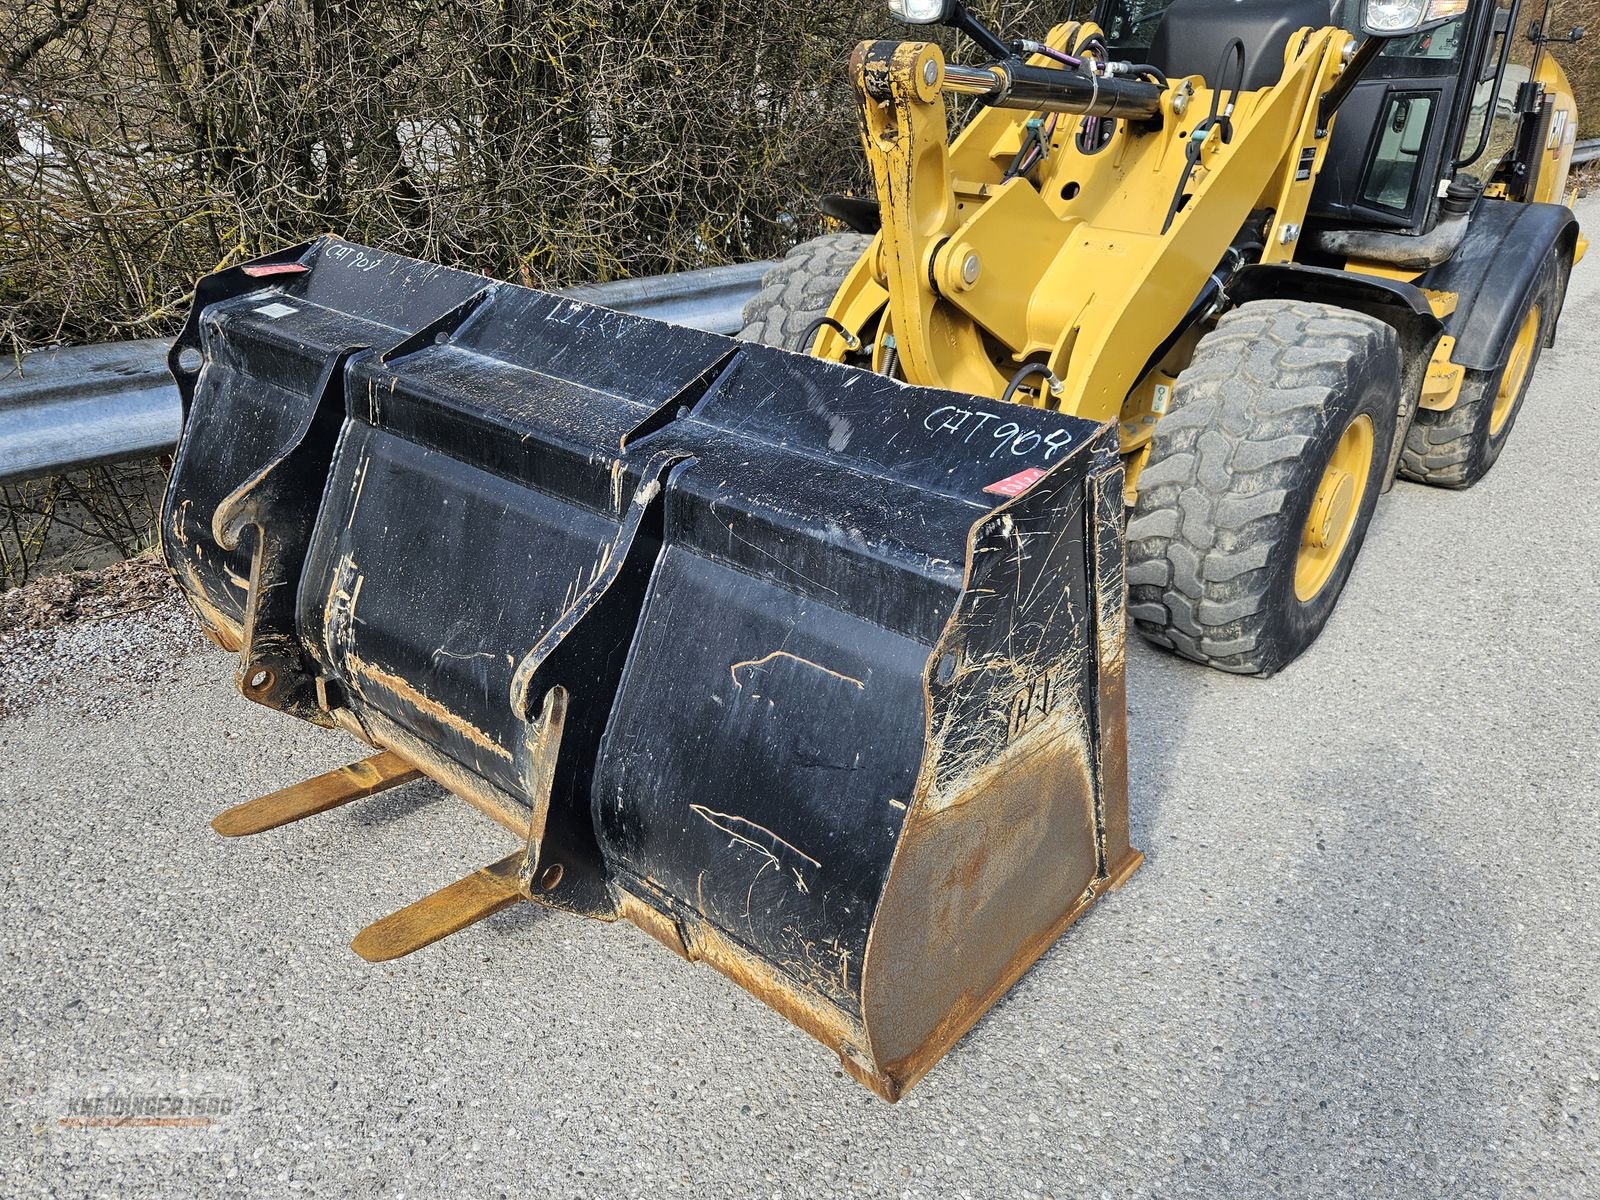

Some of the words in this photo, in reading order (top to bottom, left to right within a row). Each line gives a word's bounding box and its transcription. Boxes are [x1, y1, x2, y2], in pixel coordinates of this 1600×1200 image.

[325, 244, 355, 262] CAT
[923, 405, 1001, 443] CAT
[989, 421, 1073, 460] 908
